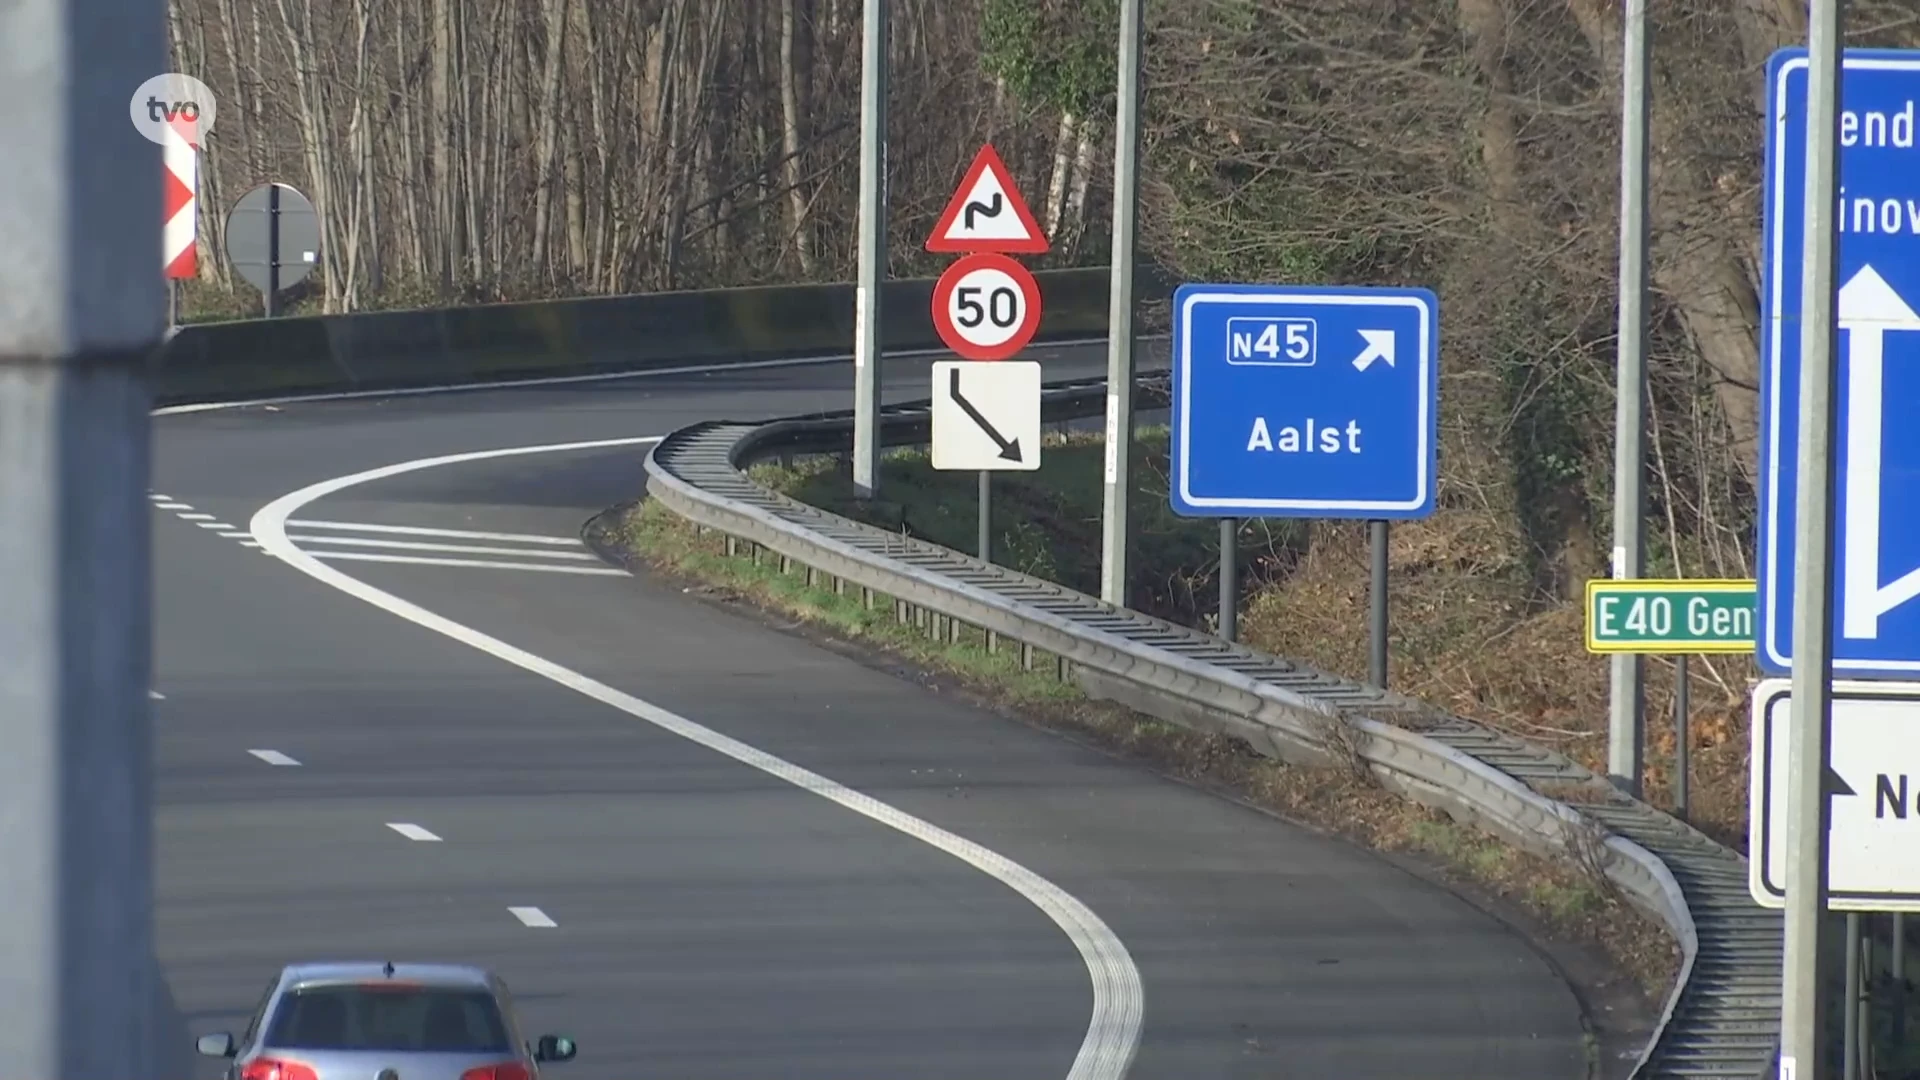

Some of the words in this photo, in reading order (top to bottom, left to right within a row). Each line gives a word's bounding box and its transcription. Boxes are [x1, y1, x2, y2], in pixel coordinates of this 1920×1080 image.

[1841, 100, 1914, 148] end
[1839, 186, 1920, 234] inov
[957, 287, 1017, 328] 50
[1233, 324, 1310, 359] N45
[1247, 417, 1361, 453] Aalst
[1688, 597, 1756, 635] Gen
[1876, 773, 1920, 820] N
